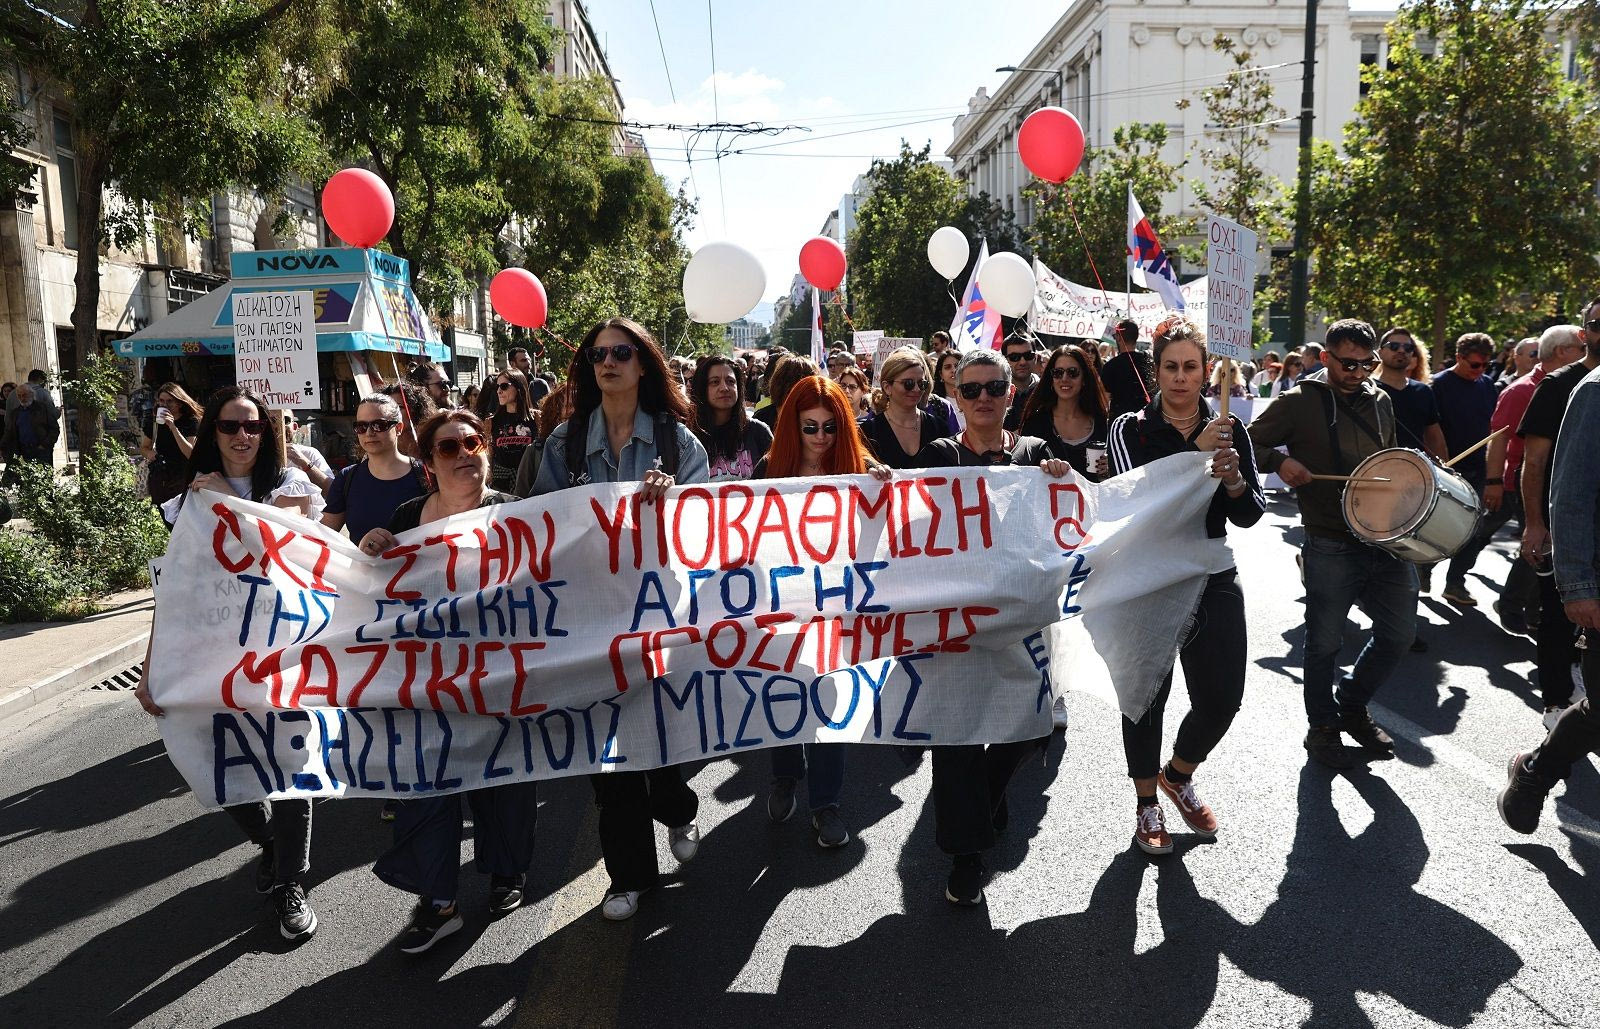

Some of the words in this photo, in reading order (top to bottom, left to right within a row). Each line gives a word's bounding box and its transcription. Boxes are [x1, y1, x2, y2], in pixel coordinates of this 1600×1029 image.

[256, 254, 340, 272] NOVA
[374, 256, 402, 276] NOVA
[1214, 249, 1246, 282] ΣΤΗΝ
[236, 295, 302, 318] ΔΙΚΑΙΩΣΗ
[1212, 302, 1243, 327] ΠΟΙΗΣΗ
[235, 323, 255, 337] ΤΩΝ
[260, 321, 302, 336] ΠΑΓΙΩΝ
[144, 343, 178, 351] NOVA
[238, 338, 303, 354] ΑΙΤΗΜΑΤΩΝ
[240, 358, 261, 373] ΤΩΝ
[212, 501, 338, 592] ΟΧΙ
[381, 510, 556, 601] ΣΤΗΝ
[589, 475, 992, 575] ΥΠΟΒΑΘΜΙΣΗ
[237, 574, 341, 648] ΤΗΣ
[221, 641, 548, 718] ΜΑΖΙΚΕΣ
[212, 706, 463, 805] ΑΥΞΗΣΕΙΣ
[483, 691, 627, 781] ΣΤΟΥΣ
[651, 653, 934, 766] ΜΙΣΘΟΥΣ
